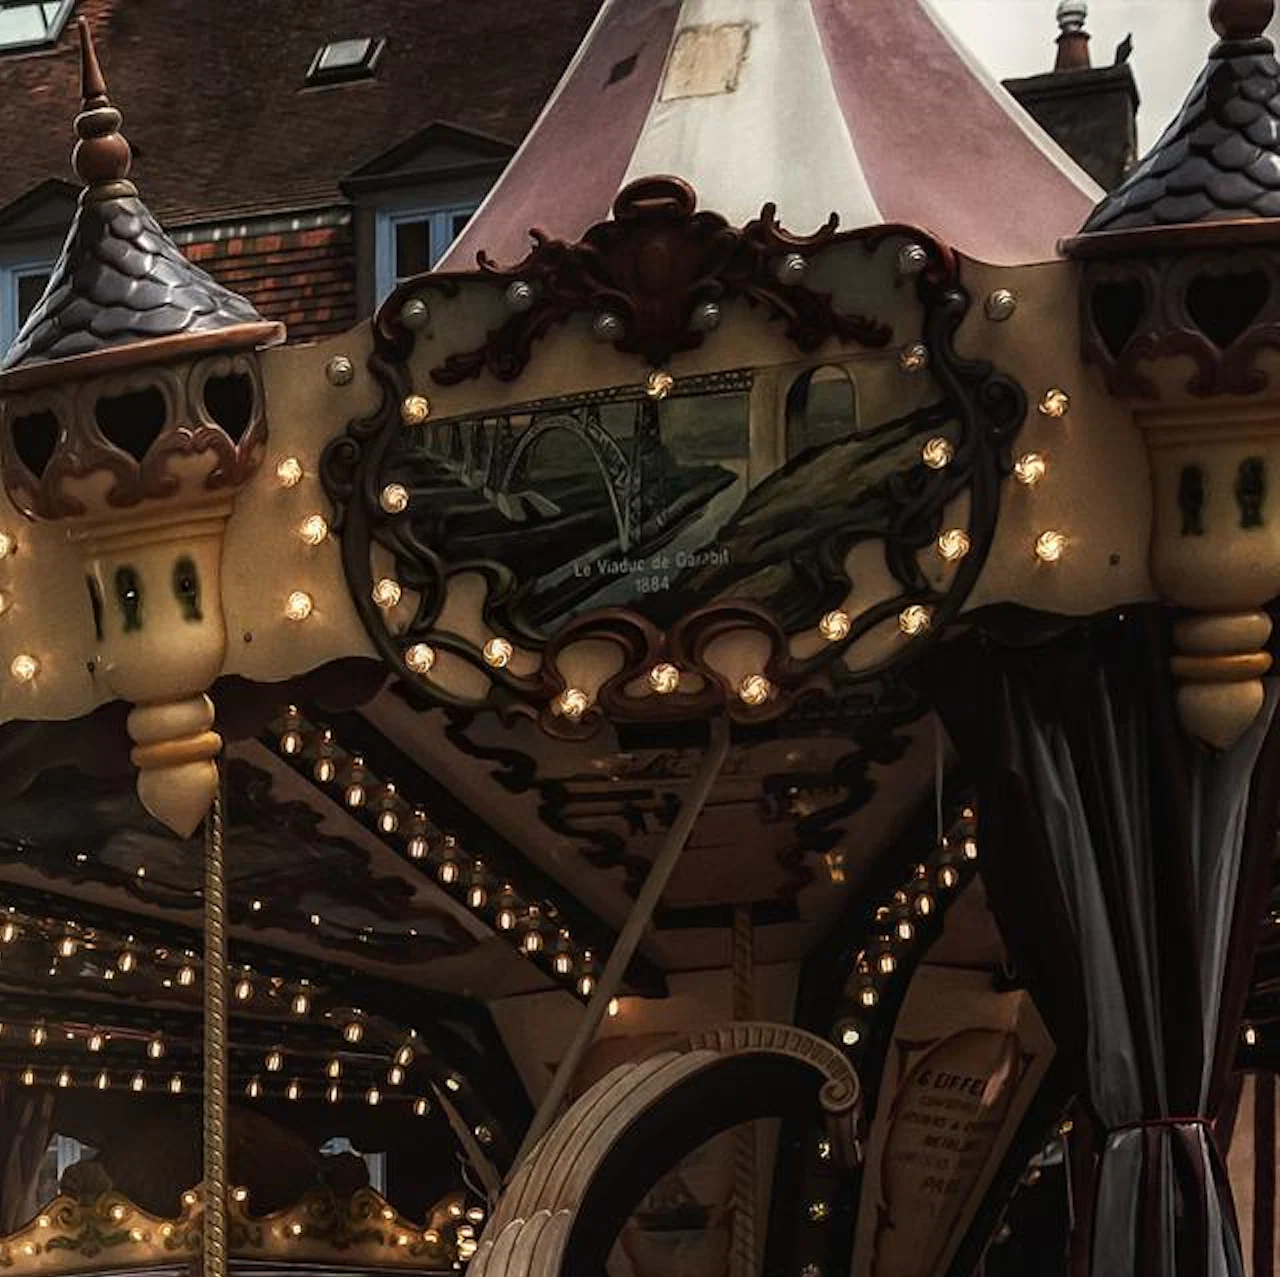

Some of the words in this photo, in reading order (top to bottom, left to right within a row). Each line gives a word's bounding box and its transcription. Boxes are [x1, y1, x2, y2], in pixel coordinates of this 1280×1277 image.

[574, 563, 591, 577] Le
[597, 556, 644, 576] Viaduc
[651, 553, 669, 570] de
[676, 548, 729, 569] Garabit
[636, 575, 670, 592] 1884
